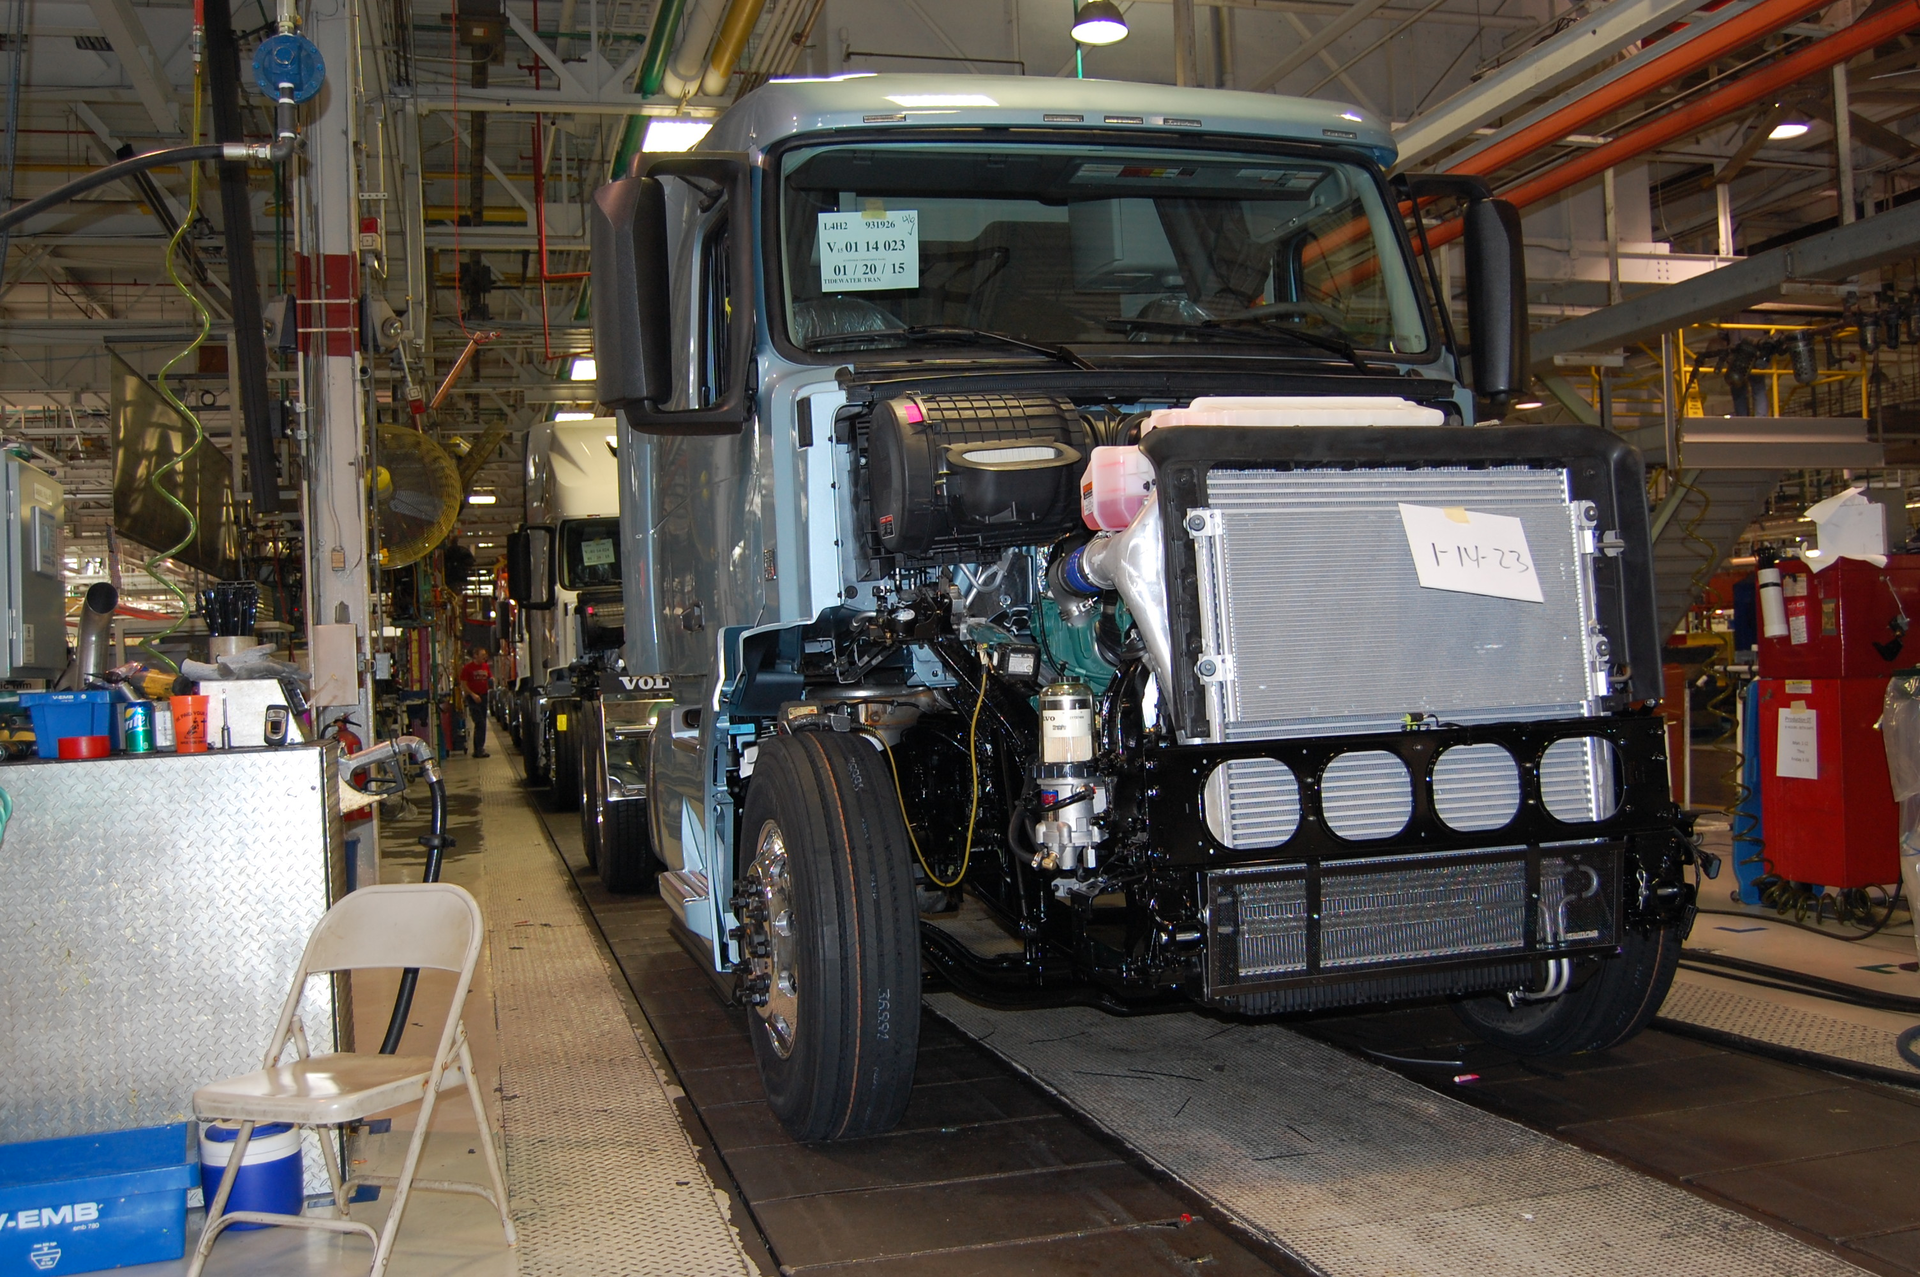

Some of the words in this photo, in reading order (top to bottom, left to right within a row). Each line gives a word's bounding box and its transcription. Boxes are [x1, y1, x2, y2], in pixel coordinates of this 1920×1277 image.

[824, 222, 848, 231] L4H2
[865, 220, 896, 230] 931926
[845, 241, 860, 253] 01
[866, 240, 880, 252] 14
[883, 240, 906, 252] 023
[834, 264, 847, 276] 01
[862, 264, 877, 276] 20
[892, 262, 905, 274] 15
[1431, 542, 1529, 573] 1-14-23
